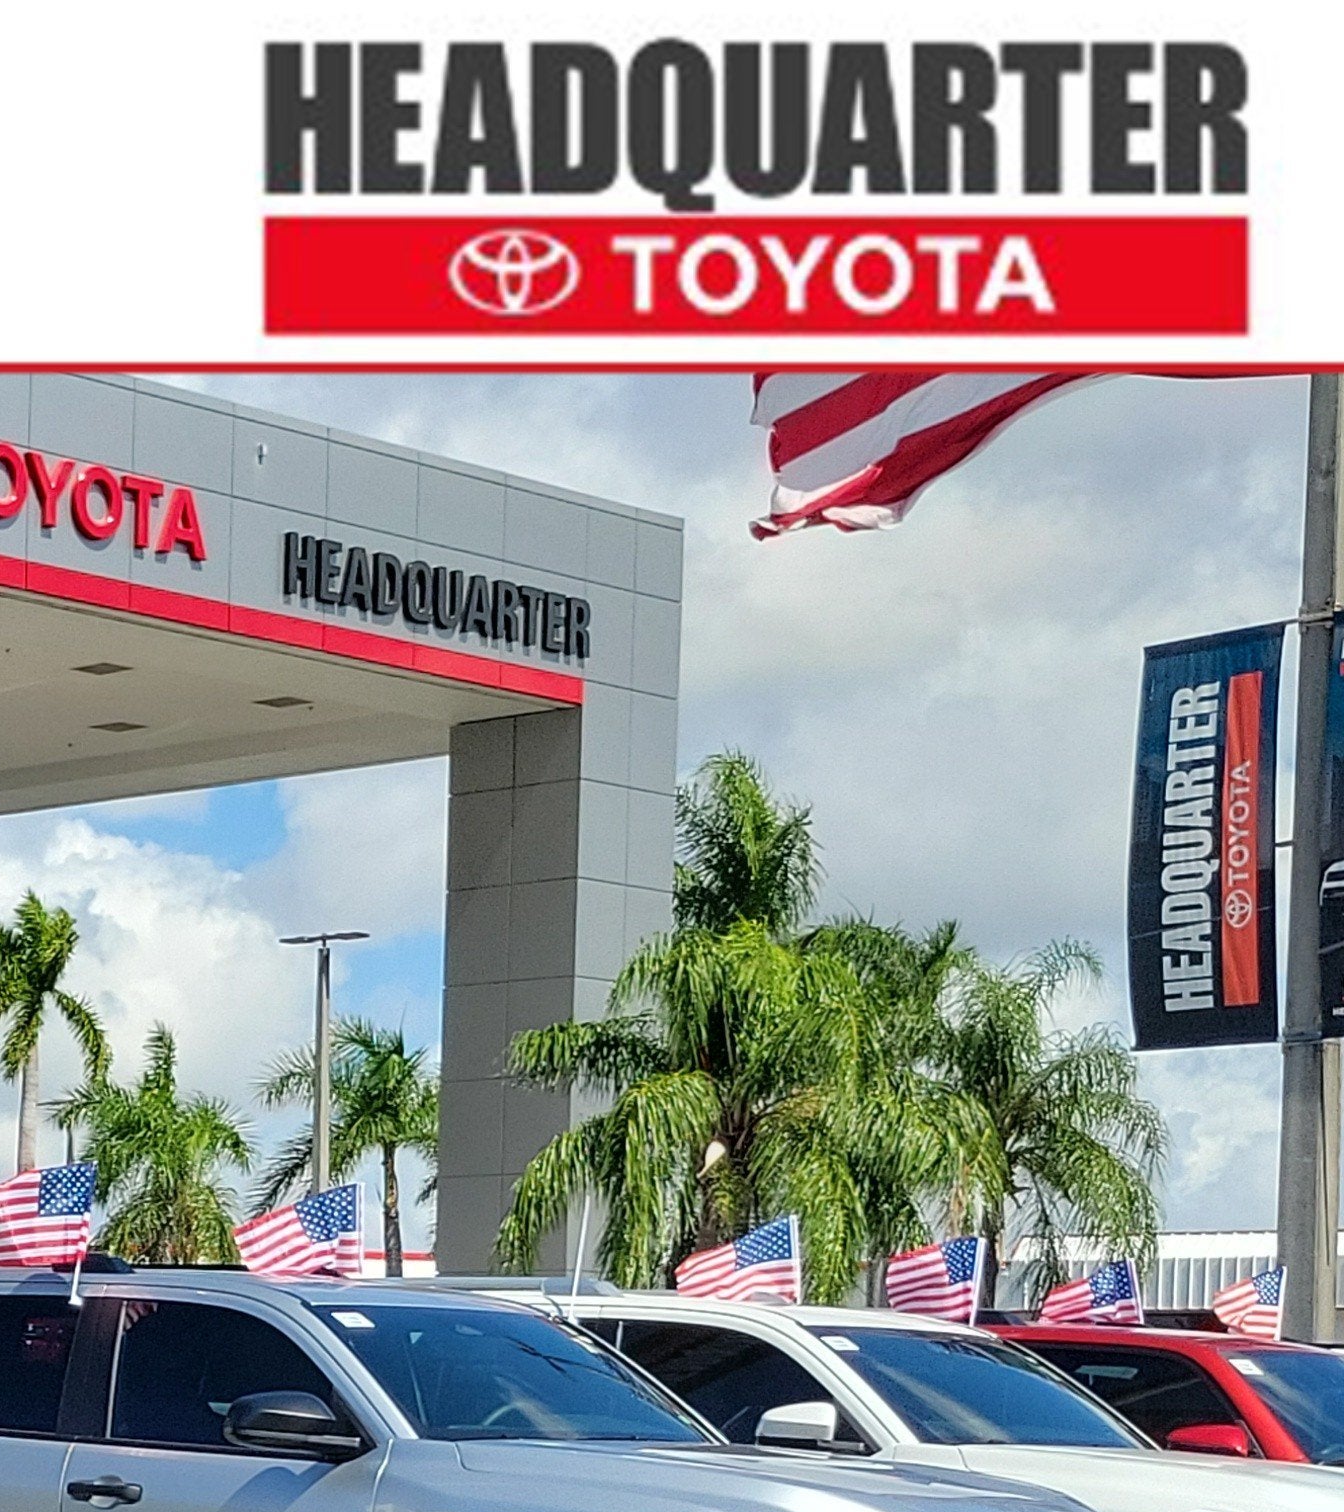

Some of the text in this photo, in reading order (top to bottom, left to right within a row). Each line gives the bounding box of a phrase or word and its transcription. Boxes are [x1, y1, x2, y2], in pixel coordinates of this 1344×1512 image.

[283, 531, 591, 659] HEADQUARTER
[1160, 680, 1221, 1012] HEADQUARTER
[1228, 760, 1252, 887] TOYOTA
